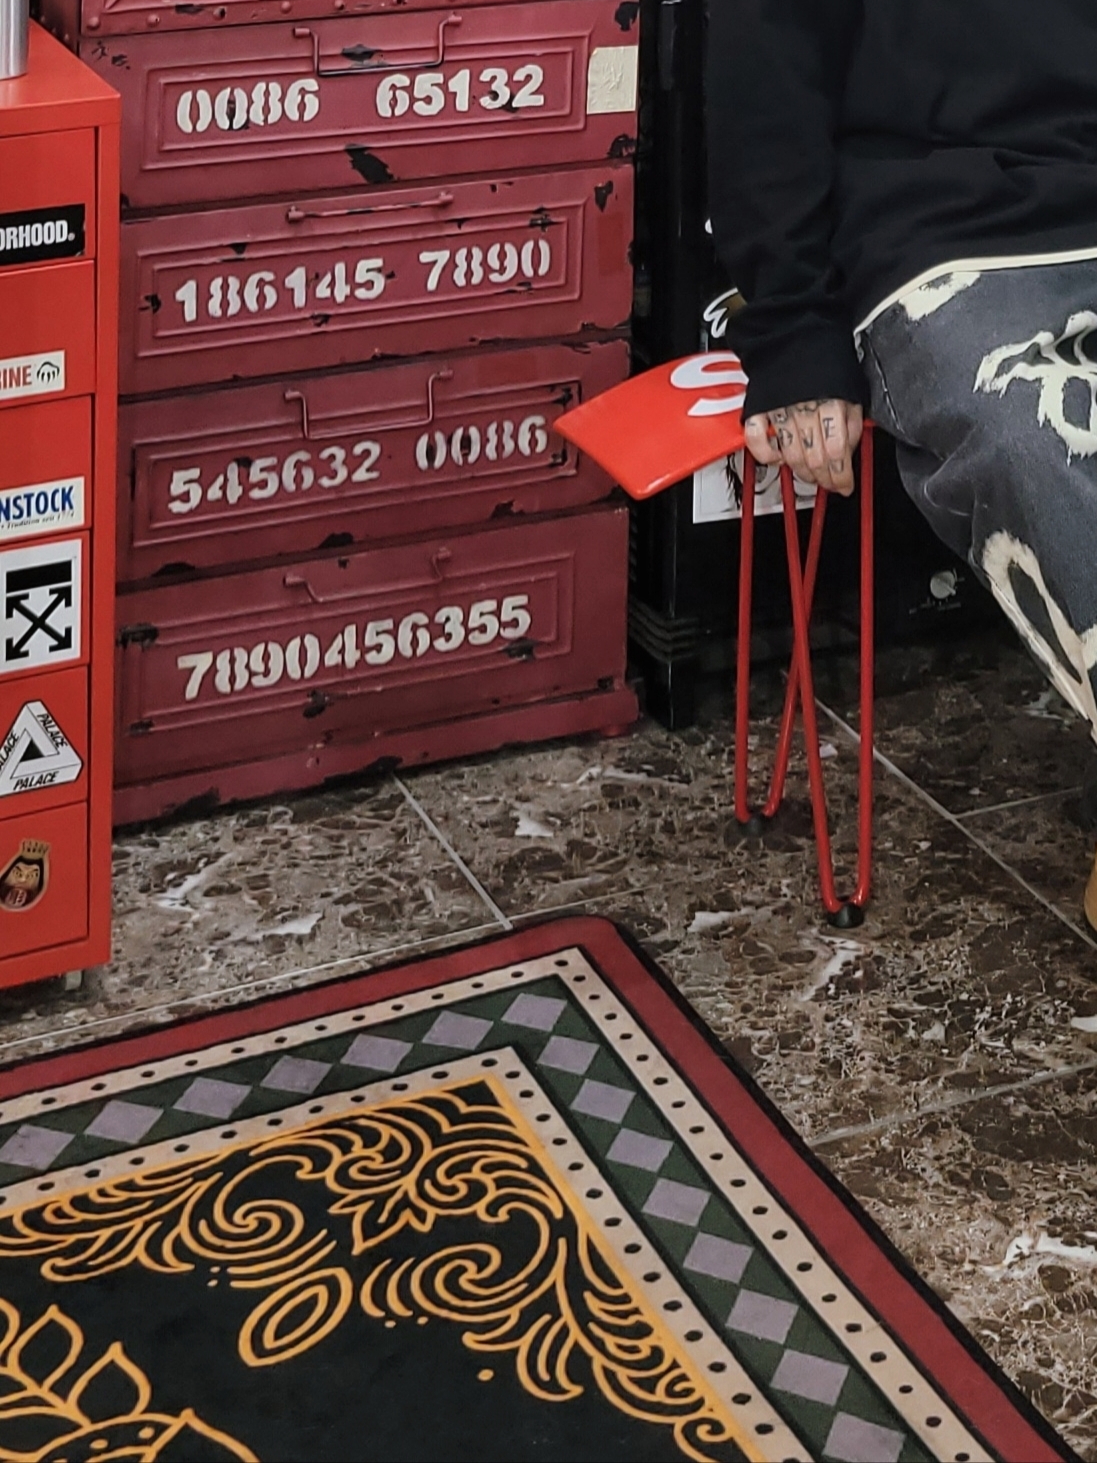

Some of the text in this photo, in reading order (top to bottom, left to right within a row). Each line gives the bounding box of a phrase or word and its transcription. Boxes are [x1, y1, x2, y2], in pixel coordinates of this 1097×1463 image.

[177, 64, 546, 134] 0086 65132
[174, 238, 552, 324] 186145 7890
[0, 364, 33, 390] INE
[168, 414, 549, 515] 545632 0086
[176, 594, 532, 700] 7890456355
[37, 712, 69, 749] PALACE
[14, 770, 60, 791] PALACE
